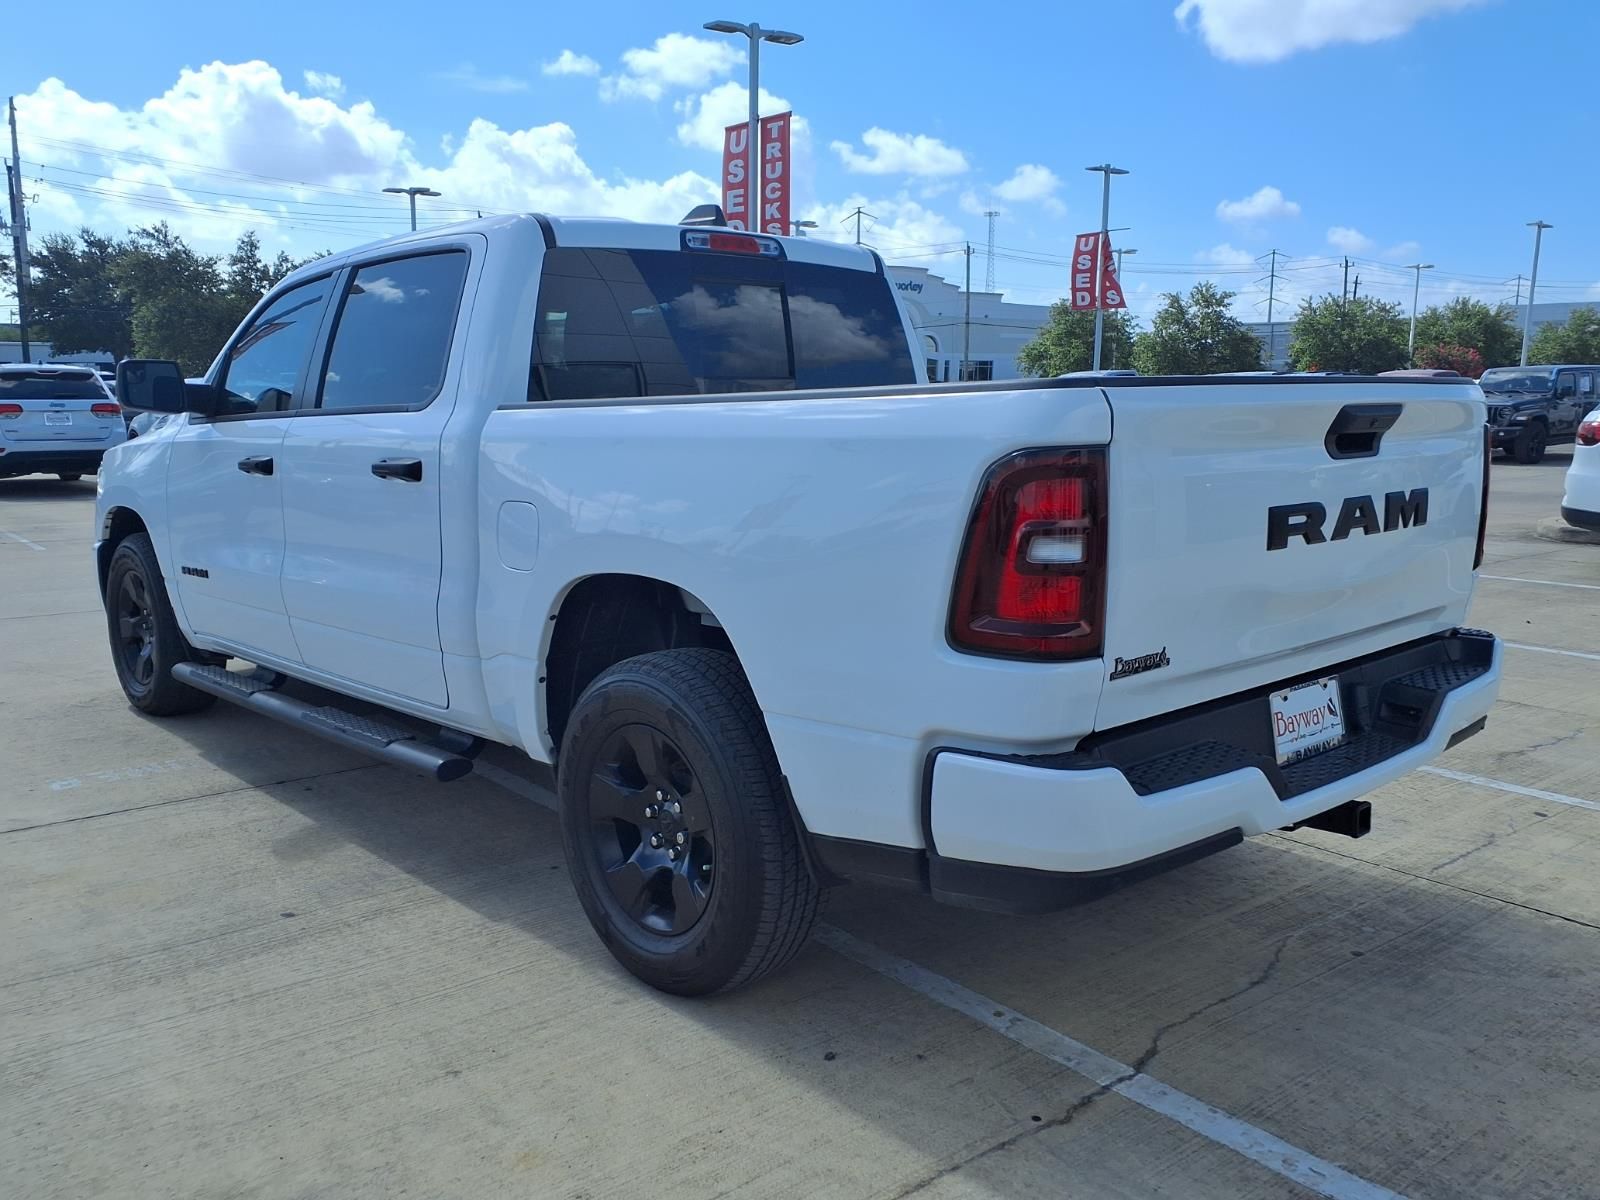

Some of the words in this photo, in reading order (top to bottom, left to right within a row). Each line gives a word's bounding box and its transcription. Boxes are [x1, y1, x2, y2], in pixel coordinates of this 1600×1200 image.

[765, 120, 783, 235] TRUCKS
[1075, 236, 1095, 306] USED
[1266, 487, 1429, 551] RAM
[1273, 705, 1326, 740] Bayway
[1295, 739, 1331, 761] BAYWAY
